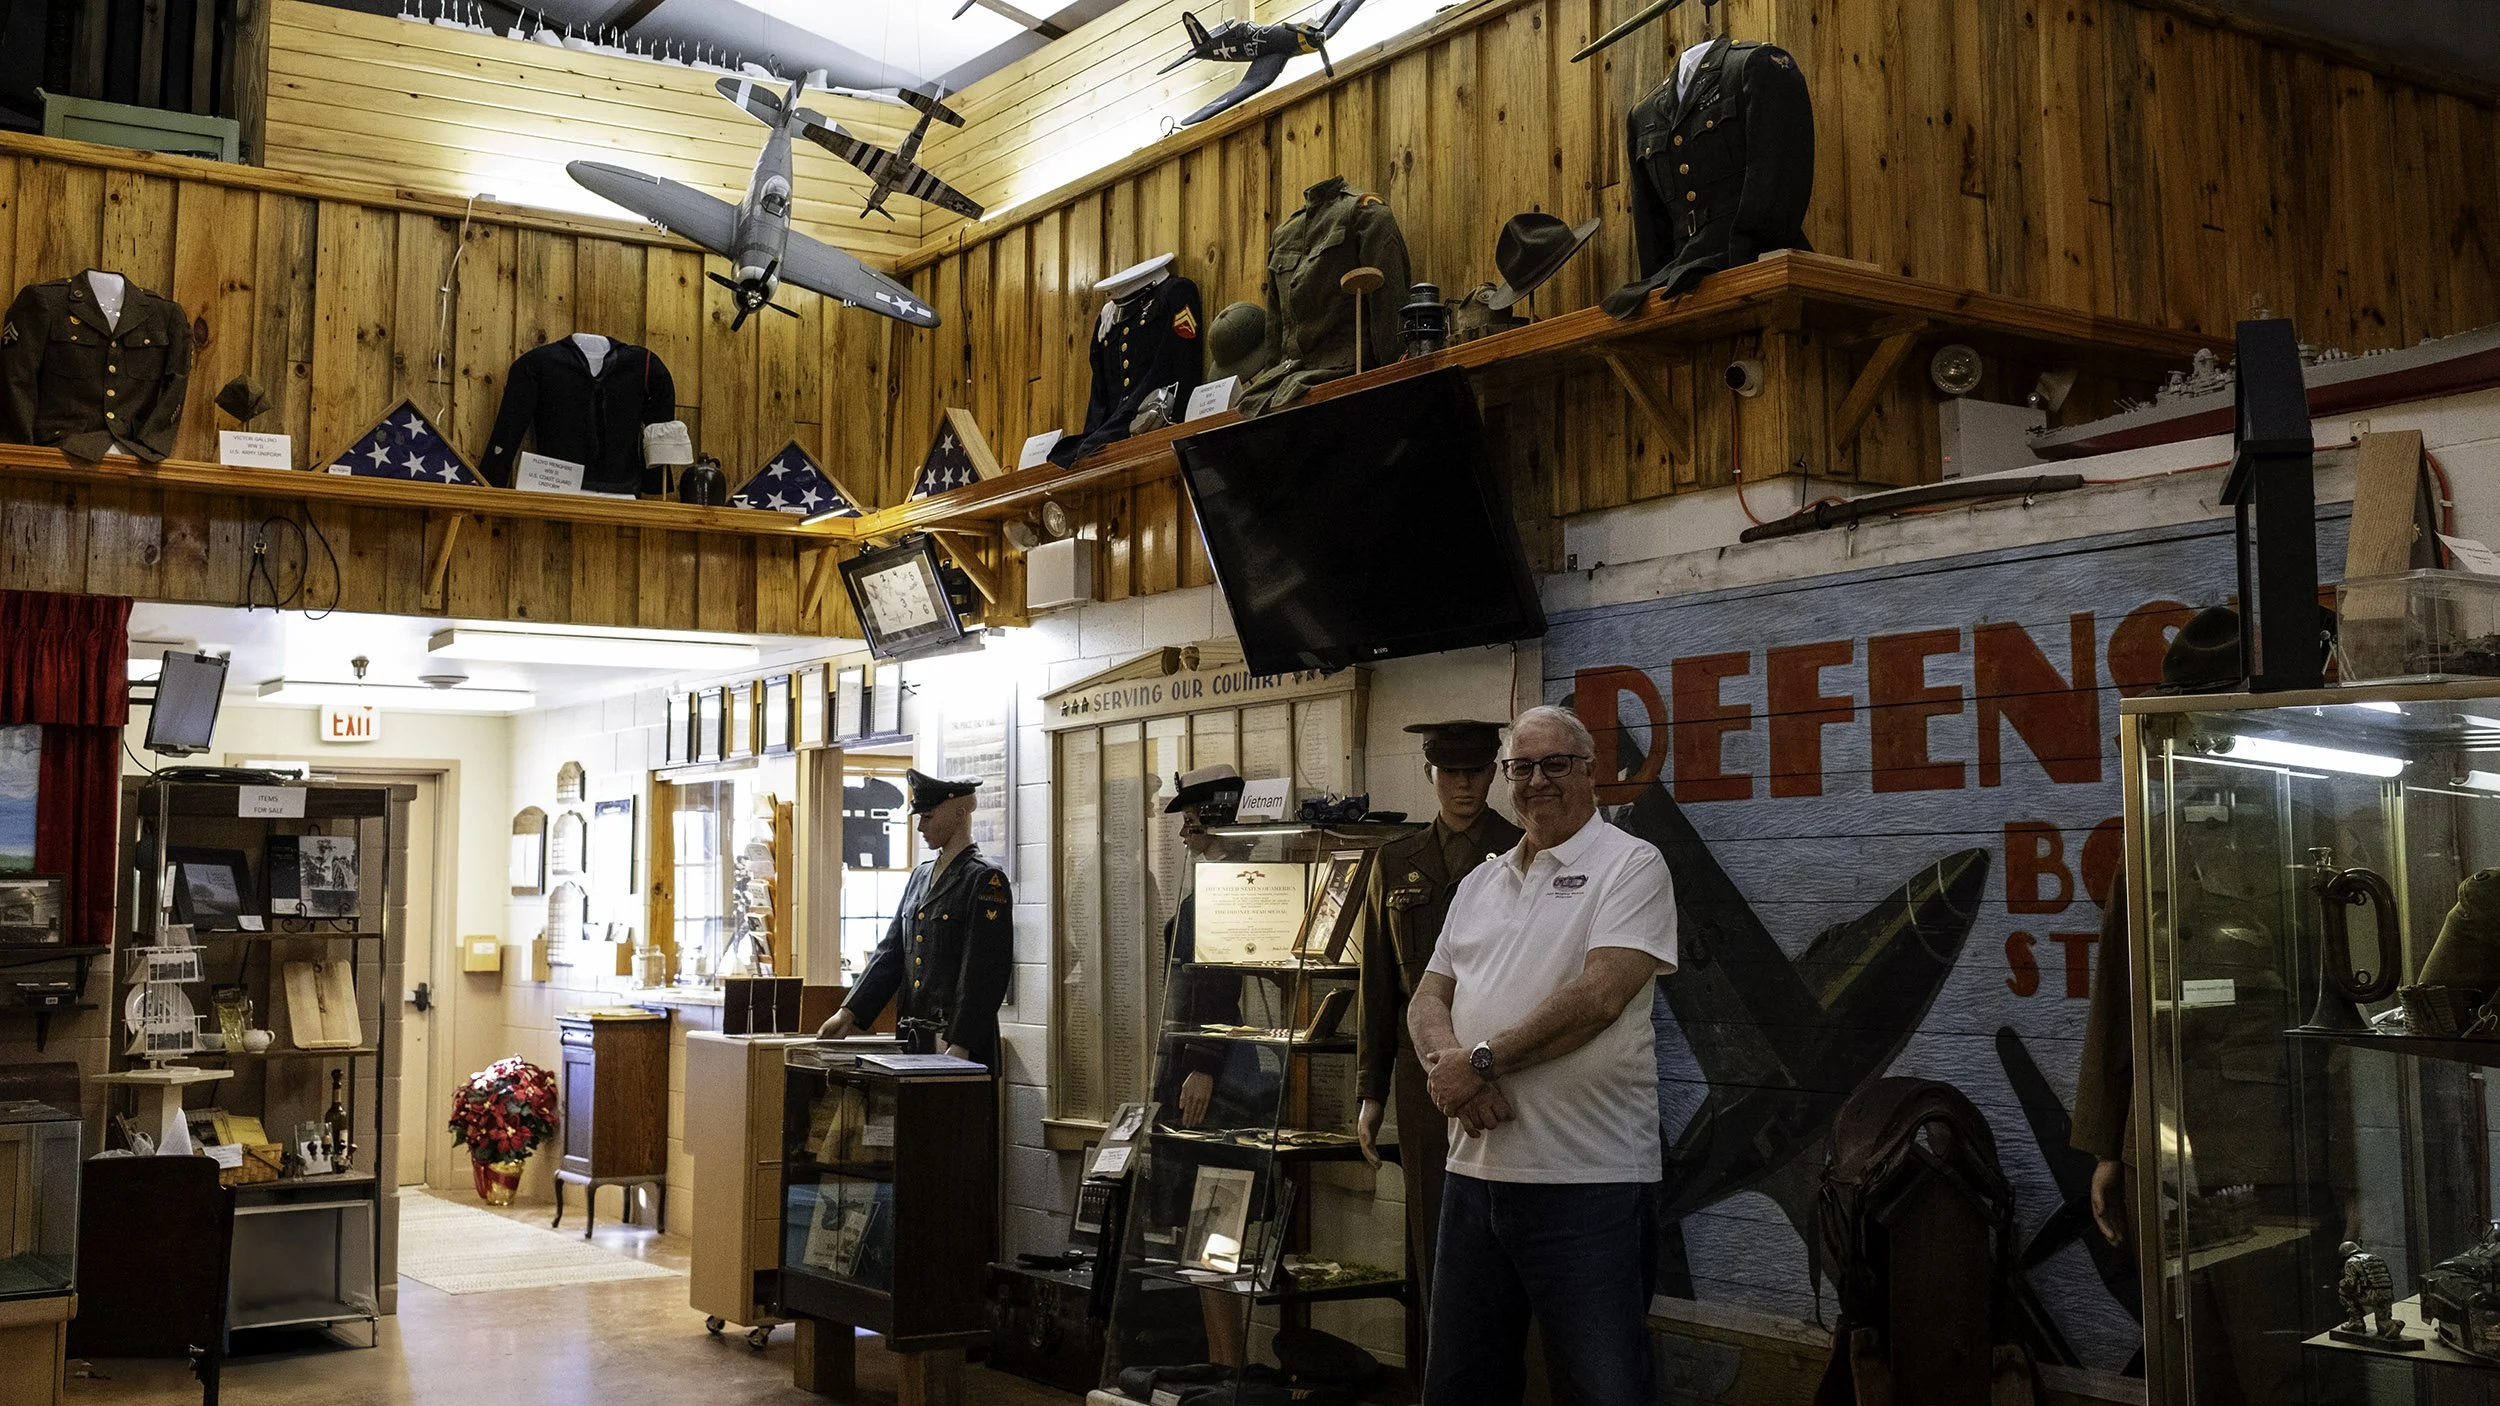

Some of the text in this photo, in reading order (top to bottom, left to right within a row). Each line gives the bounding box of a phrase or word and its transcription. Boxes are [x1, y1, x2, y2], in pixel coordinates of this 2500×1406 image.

[879, 574, 886, 583] 2
[900, 598, 907, 608] 3
[1093, 683, 1162, 713] SERVING
[1172, 678, 1203, 700] OUR
[1574, 600, 2238, 806] DEFEN
[1242, 795, 1283, 809] Vietnam
